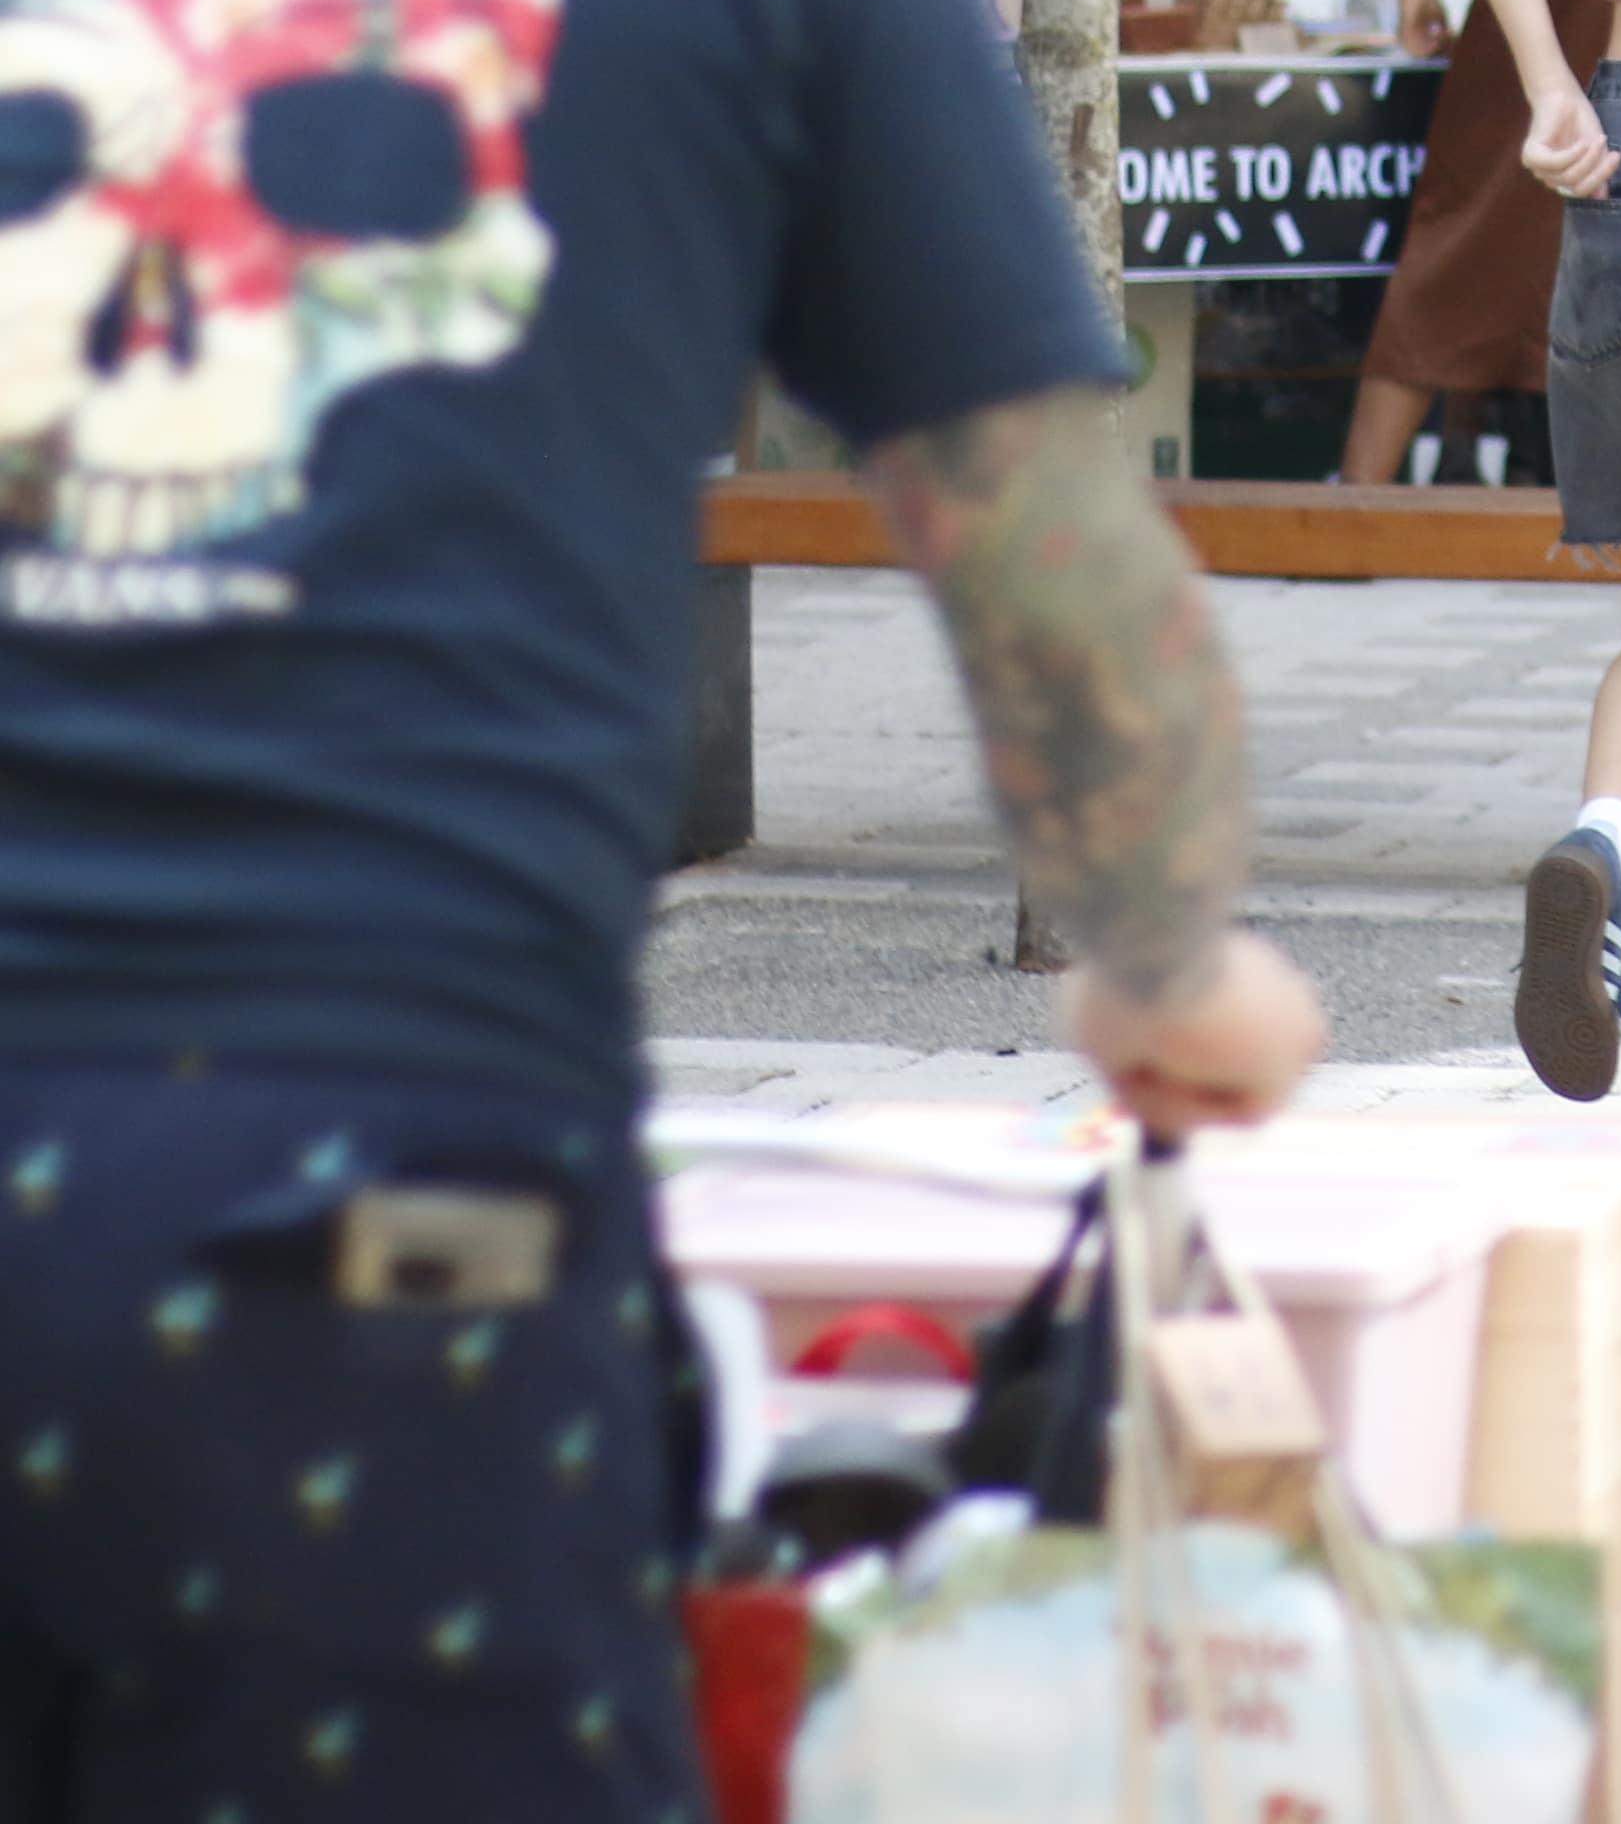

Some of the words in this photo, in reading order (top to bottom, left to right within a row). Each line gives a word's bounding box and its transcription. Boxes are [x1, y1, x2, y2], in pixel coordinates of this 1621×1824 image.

[1119, 146, 1219, 203] OME
[1230, 144, 1291, 202] TO
[1305, 142, 1427, 200] ARCH
